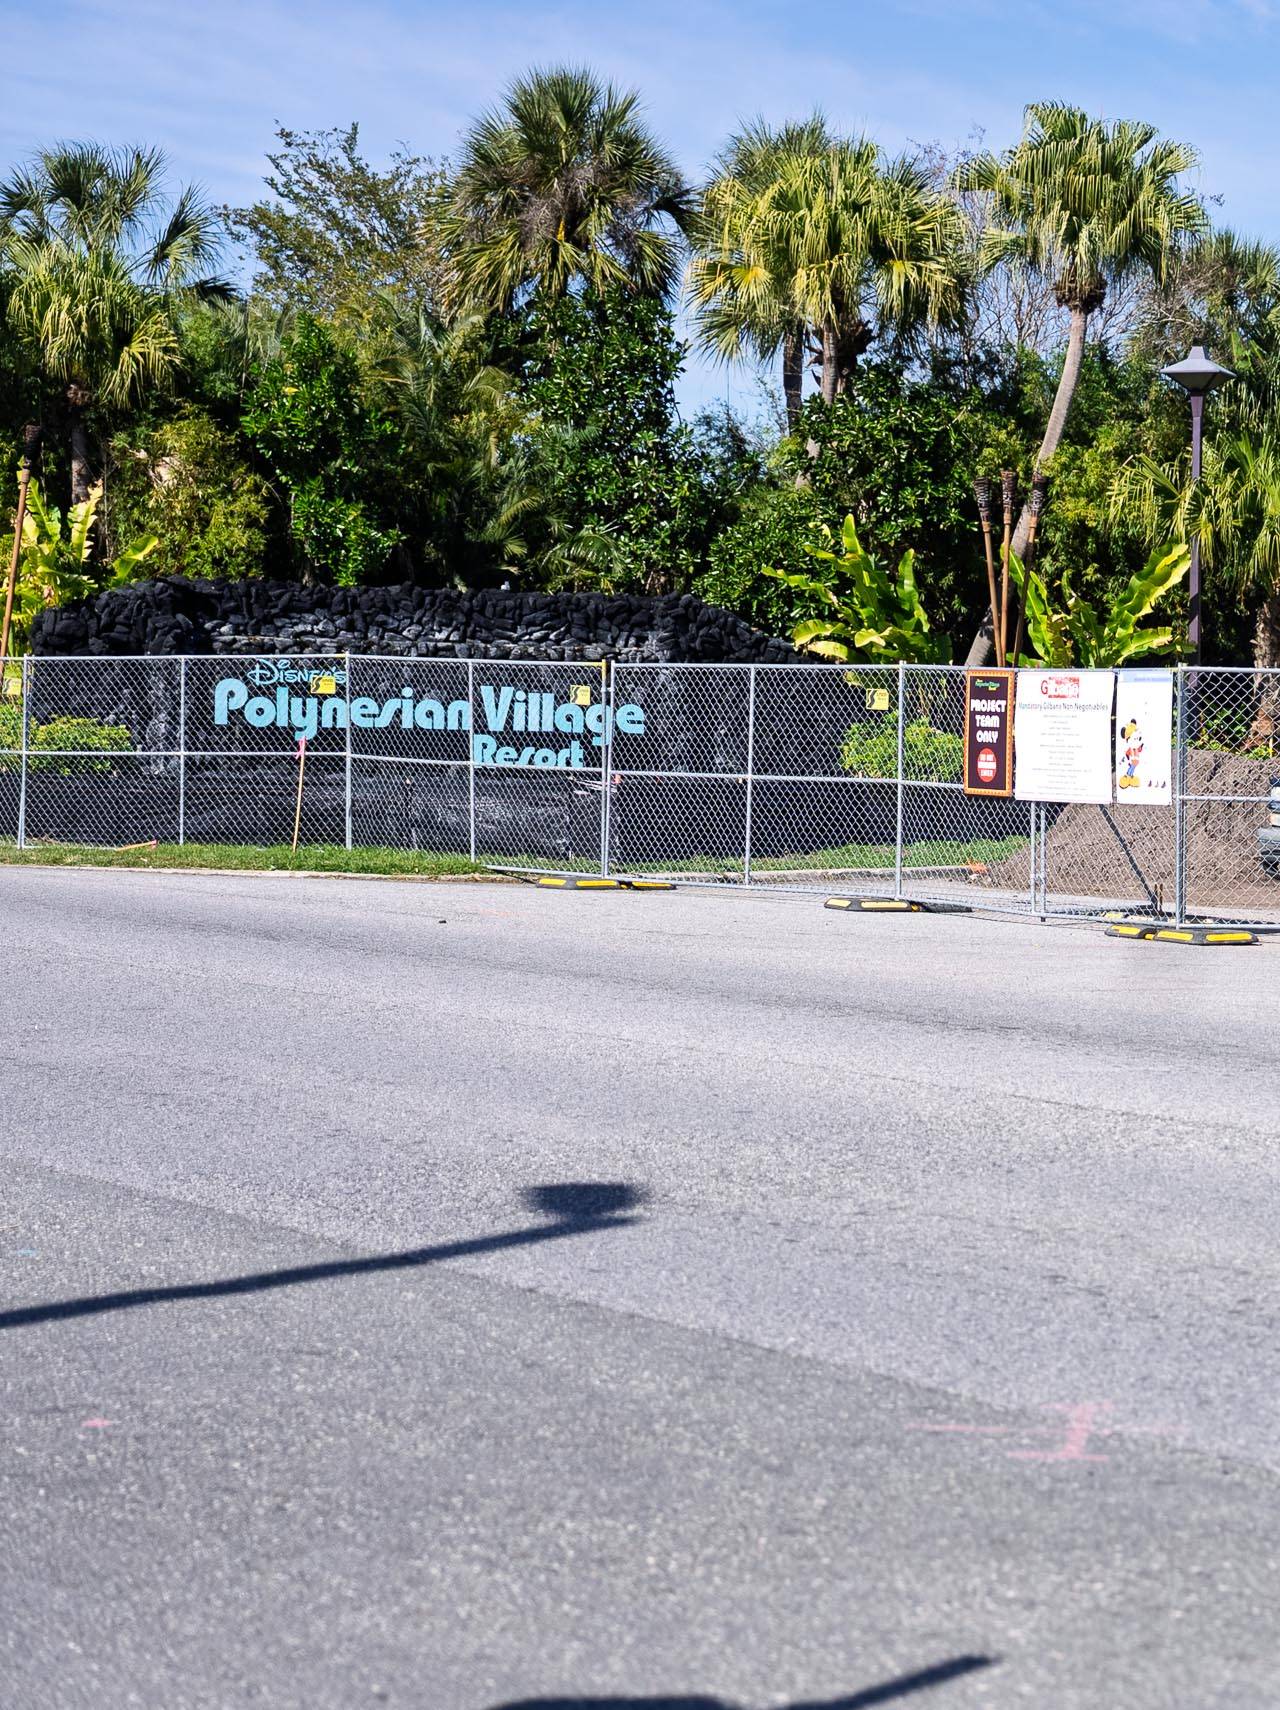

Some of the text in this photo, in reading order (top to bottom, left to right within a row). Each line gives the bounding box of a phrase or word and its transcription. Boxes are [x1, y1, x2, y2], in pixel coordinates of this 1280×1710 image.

[214, 678, 645, 746] Polynesian Village
[970, 699, 1006, 713] PROJECT
[1062, 702, 1073, 710] Non
[1075, 702, 1108, 712] Negotiables
[975, 715, 1000, 728] TEAM
[976, 730, 999, 744] ONLY
[473, 734, 584, 768] Resort
